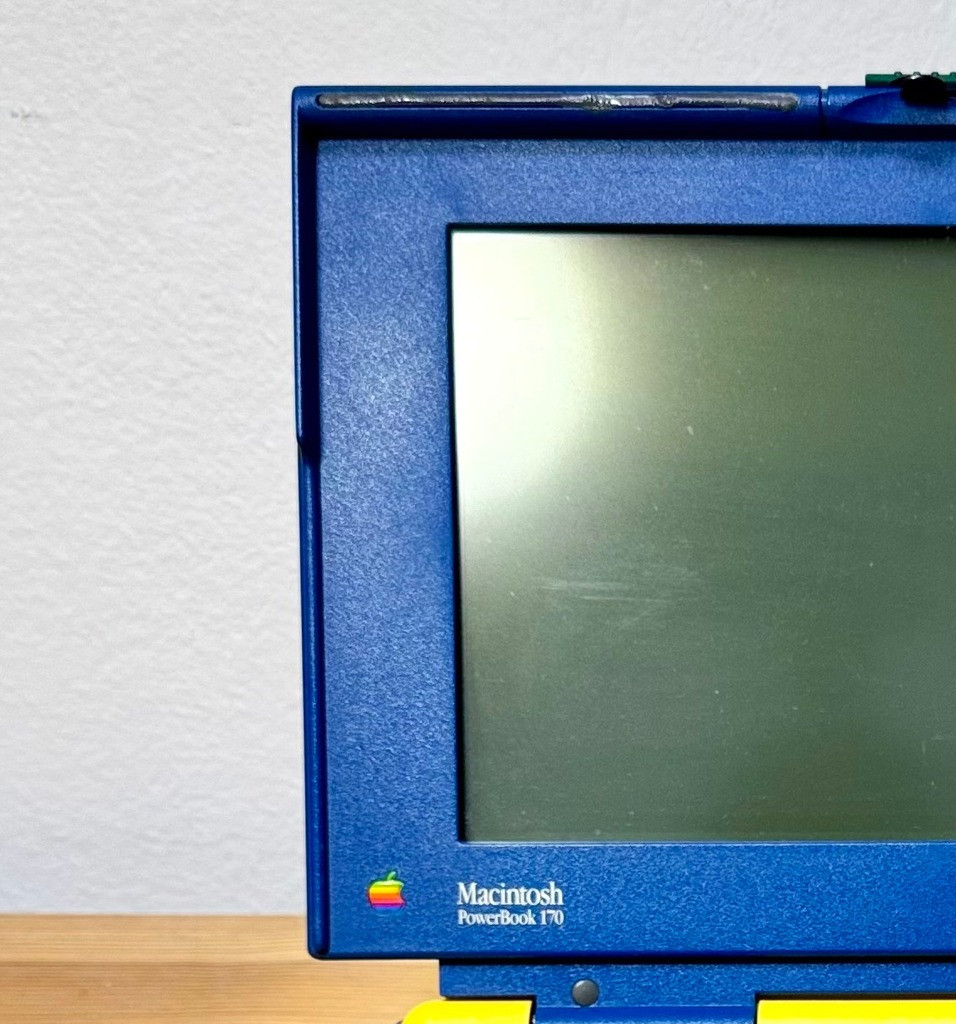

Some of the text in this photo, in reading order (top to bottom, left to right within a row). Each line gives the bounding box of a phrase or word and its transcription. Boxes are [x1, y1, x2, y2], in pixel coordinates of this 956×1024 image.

[456, 880, 564, 906] Macintosh
[457, 908, 565, 926] PowerBook 170
